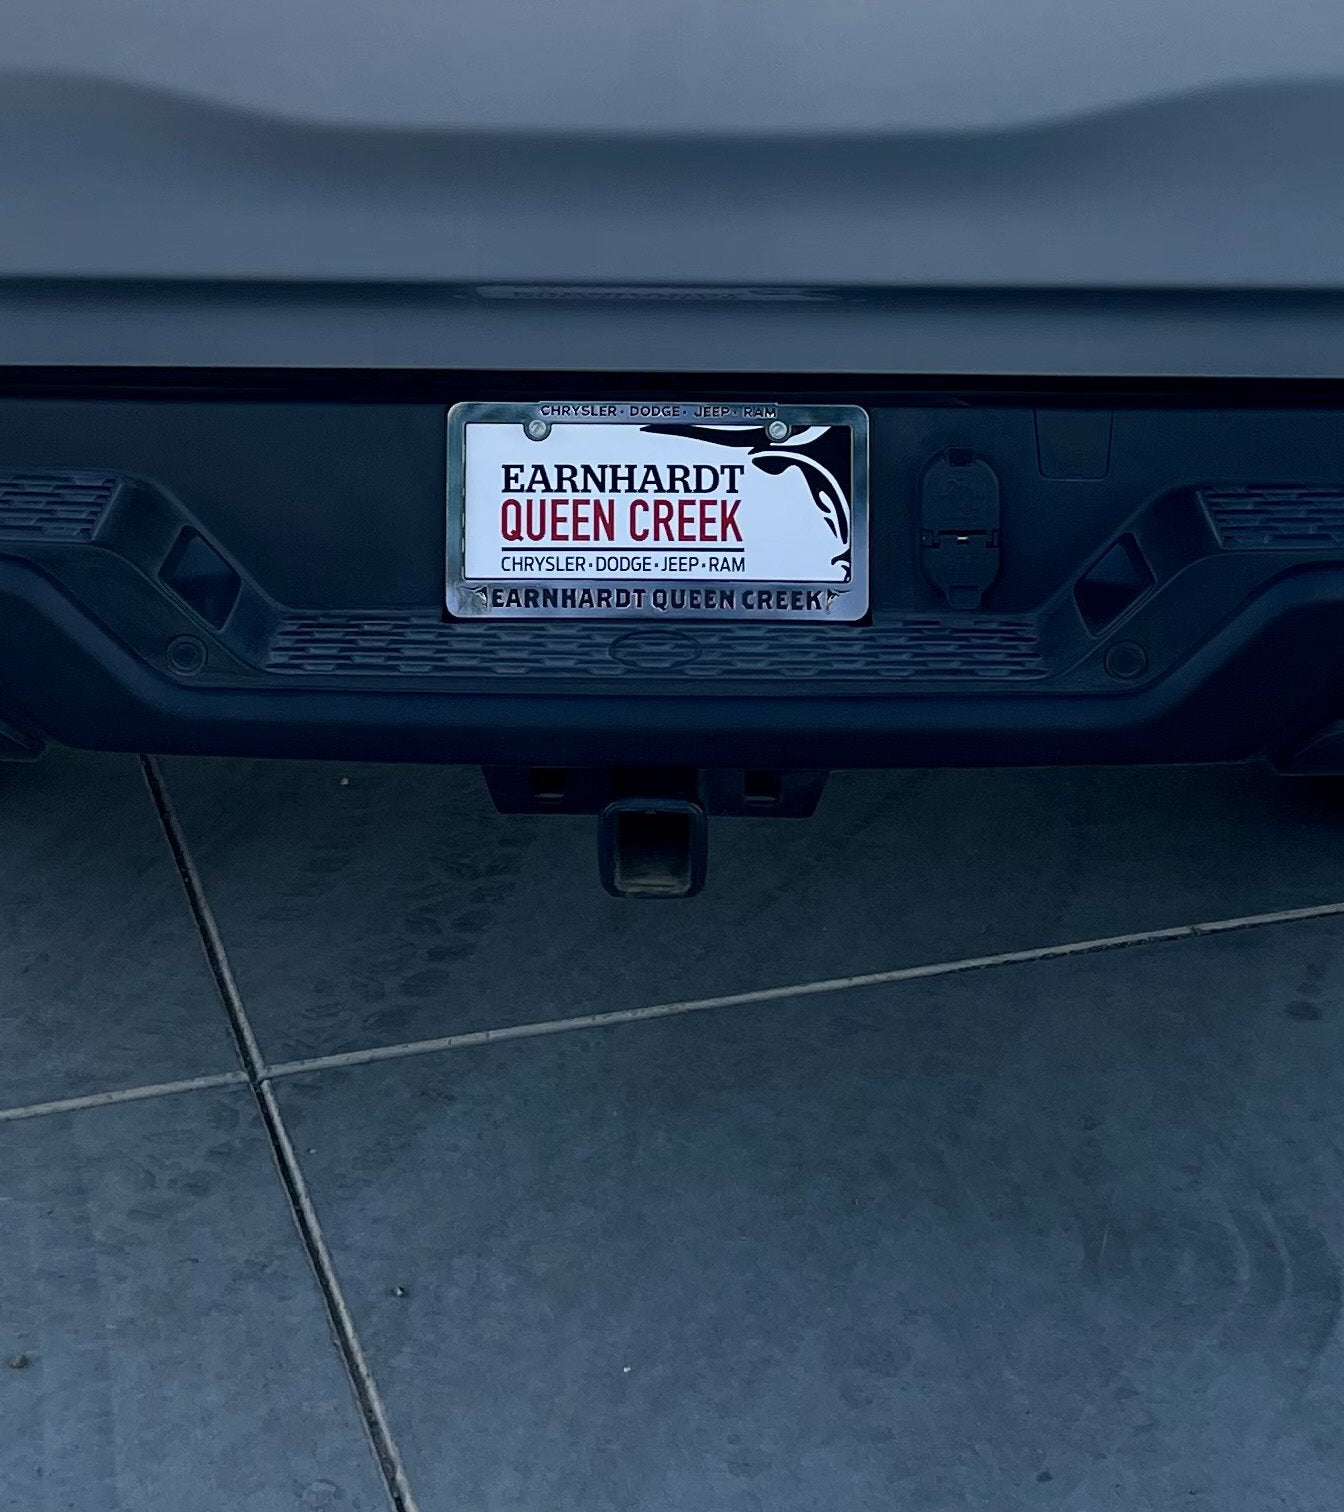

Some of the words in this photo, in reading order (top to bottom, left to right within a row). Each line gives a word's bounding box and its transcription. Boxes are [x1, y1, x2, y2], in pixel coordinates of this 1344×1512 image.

[540, 405, 618, 417] CHRYSLER
[629, 405, 681, 418] DODGE
[693, 406, 731, 418] JEEP
[742, 406, 777, 419] RAM
[501, 464, 745, 493] EARNHARDT
[501, 498, 615, 542] QUEEN
[629, 499, 743, 542] CREEK
[501, 556, 586, 573] CHRYSLER
[596, 556, 652, 573] DODGE
[660, 556, 700, 573] JEEP
[708, 556, 746, 573] RAM
[491, 587, 646, 609] EARNHARDT
[652, 589, 734, 612] QUEEN
[741, 589, 823, 611] CREEK
